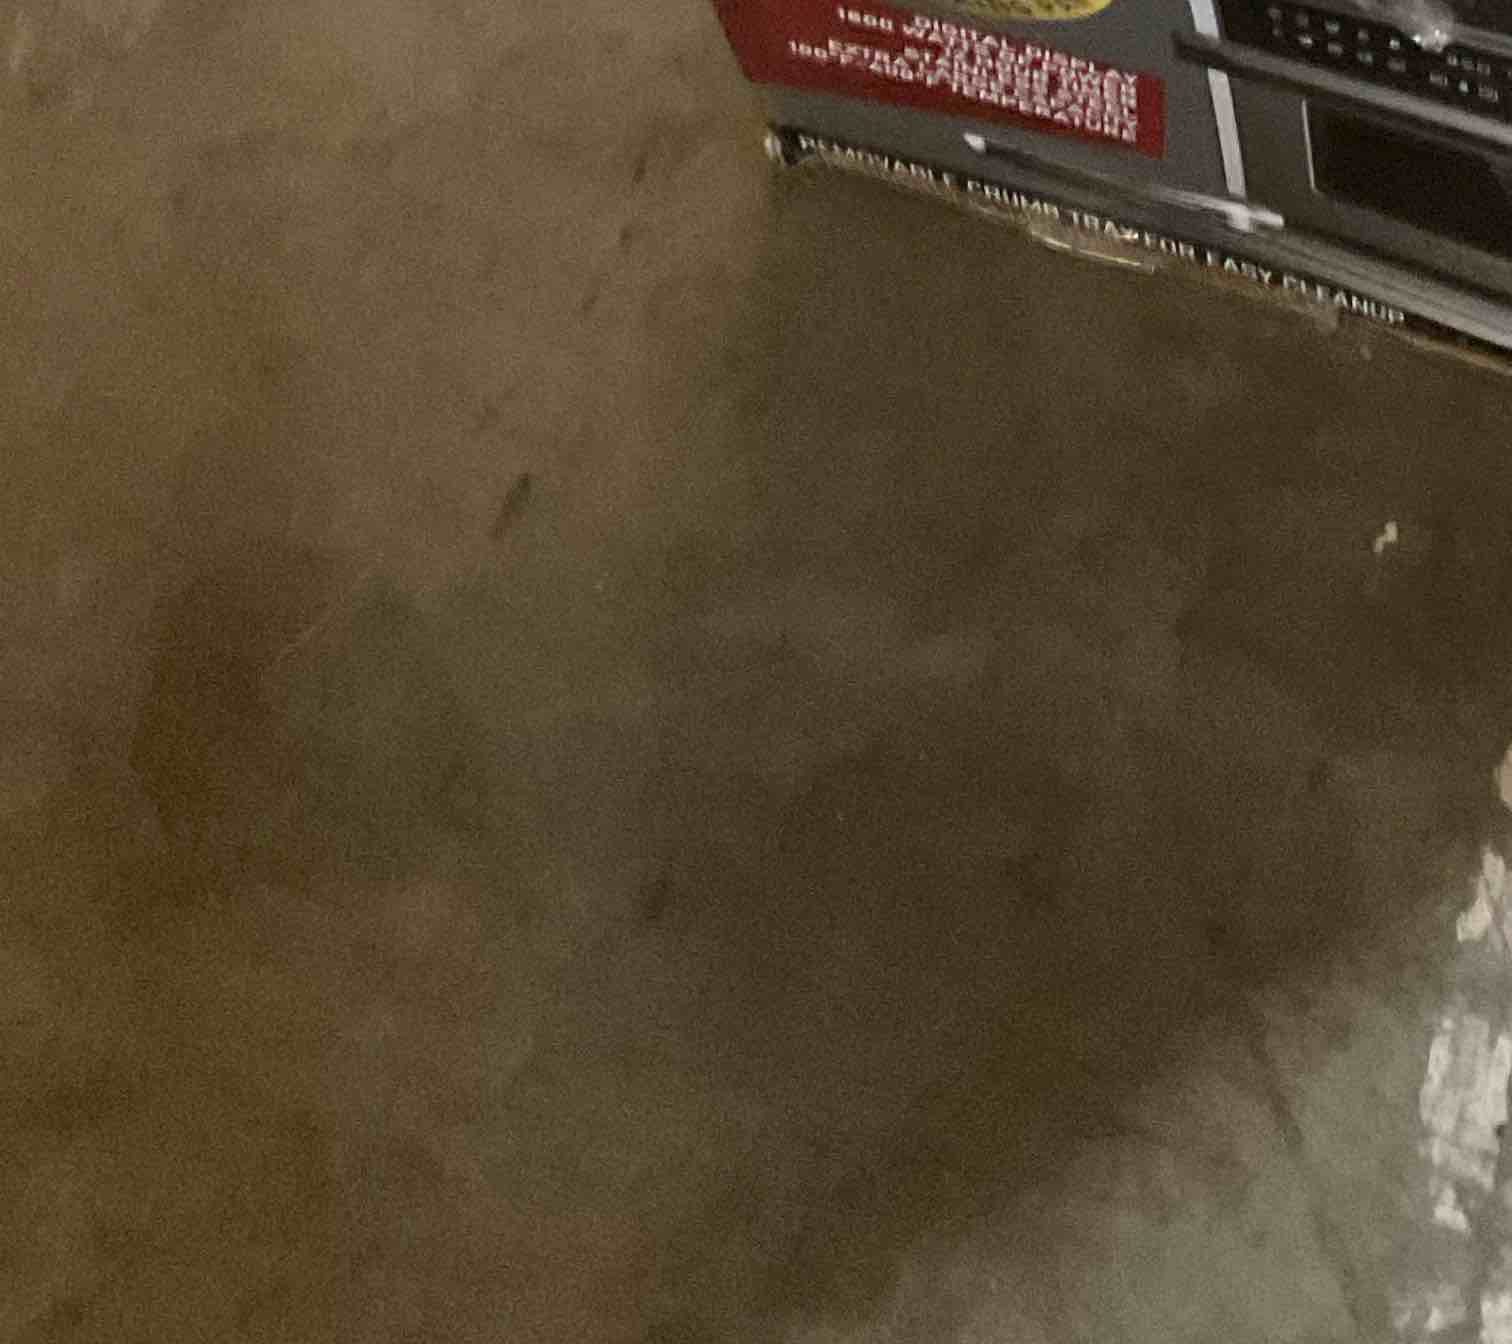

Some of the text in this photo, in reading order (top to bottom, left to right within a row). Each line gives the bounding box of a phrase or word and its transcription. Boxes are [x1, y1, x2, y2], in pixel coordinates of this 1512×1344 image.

[913, 15, 1018, 53] DIGITAL
[948, 80, 1138, 144] TEMPERATURE
[964, 179, 1062, 218] CRUMB
[1203, 249, 1273, 283] EASY
[1281, 272, 1406, 326] CLEANUP
